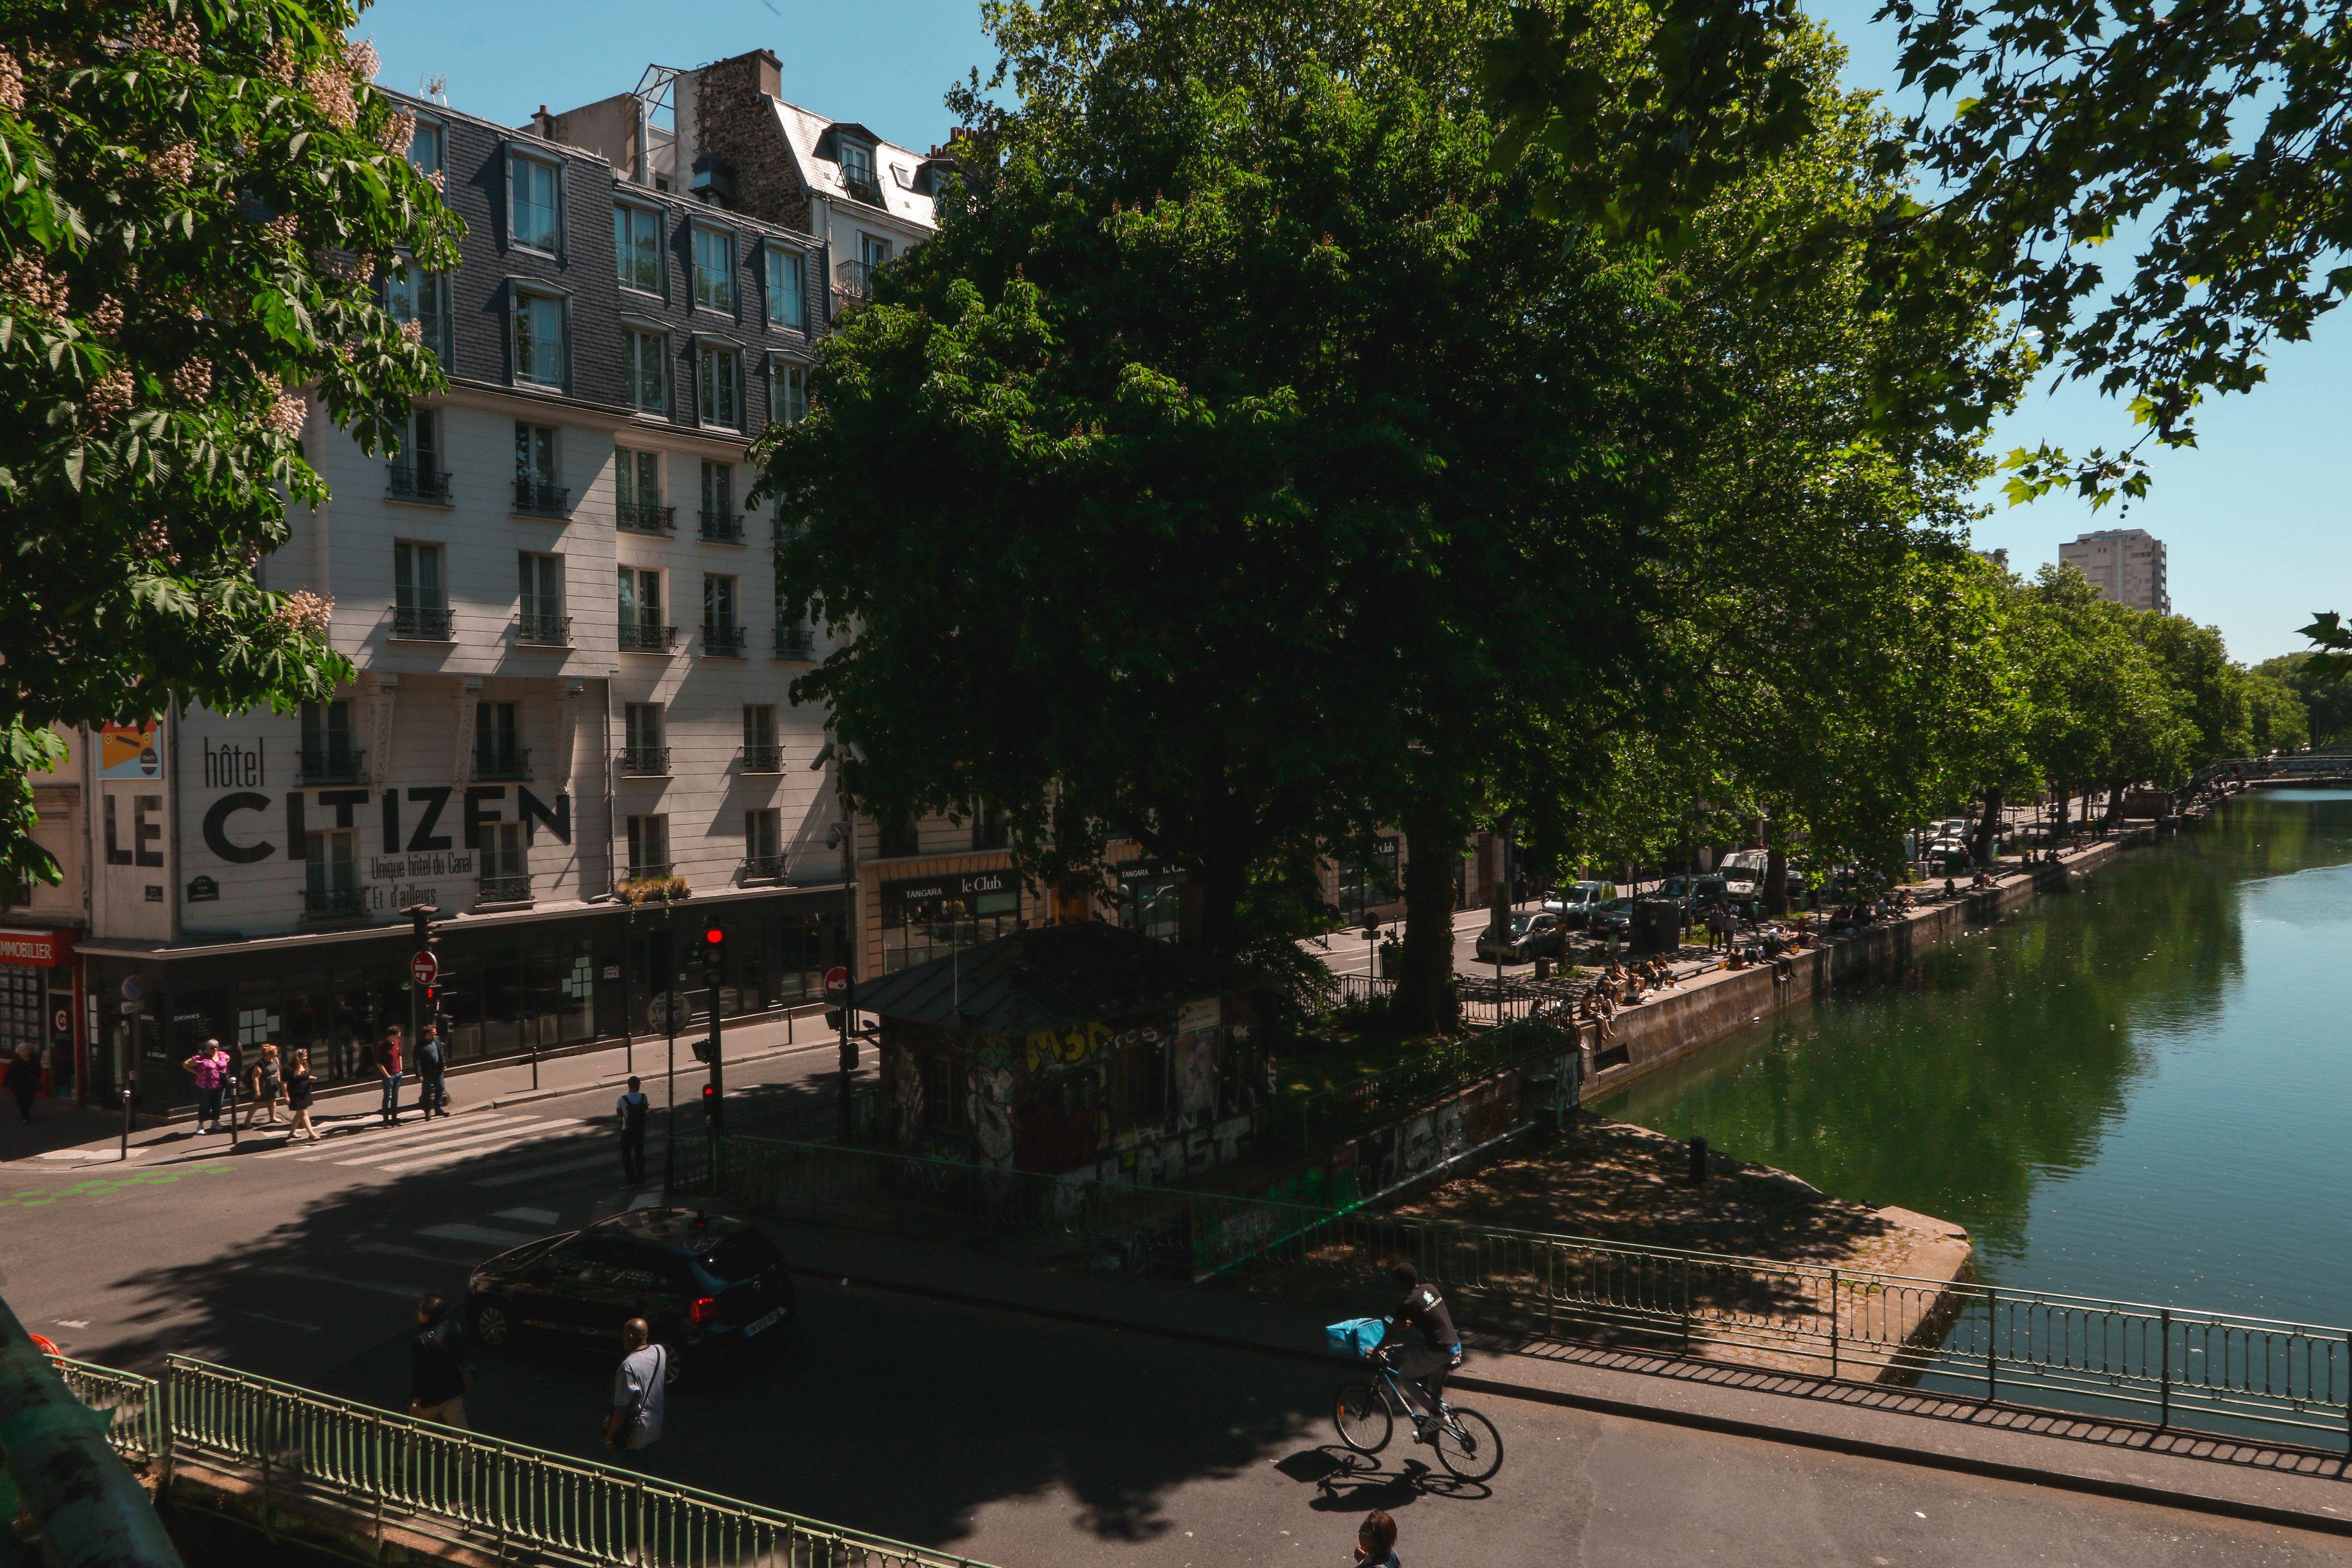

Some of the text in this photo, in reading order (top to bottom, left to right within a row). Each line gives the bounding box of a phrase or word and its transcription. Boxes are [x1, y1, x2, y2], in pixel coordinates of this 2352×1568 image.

[204, 737, 265, 788] hôtel
[105, 785, 571, 867] LE CITIZEN
[372, 851, 472, 883] Unique hôtel du Canal
[1121, 869, 1149, 878] TANGARA
[373, 884, 436, 910] Et d'ailleurs
[906, 888, 942, 899] TANGARA
[962, 879, 971, 892] le
